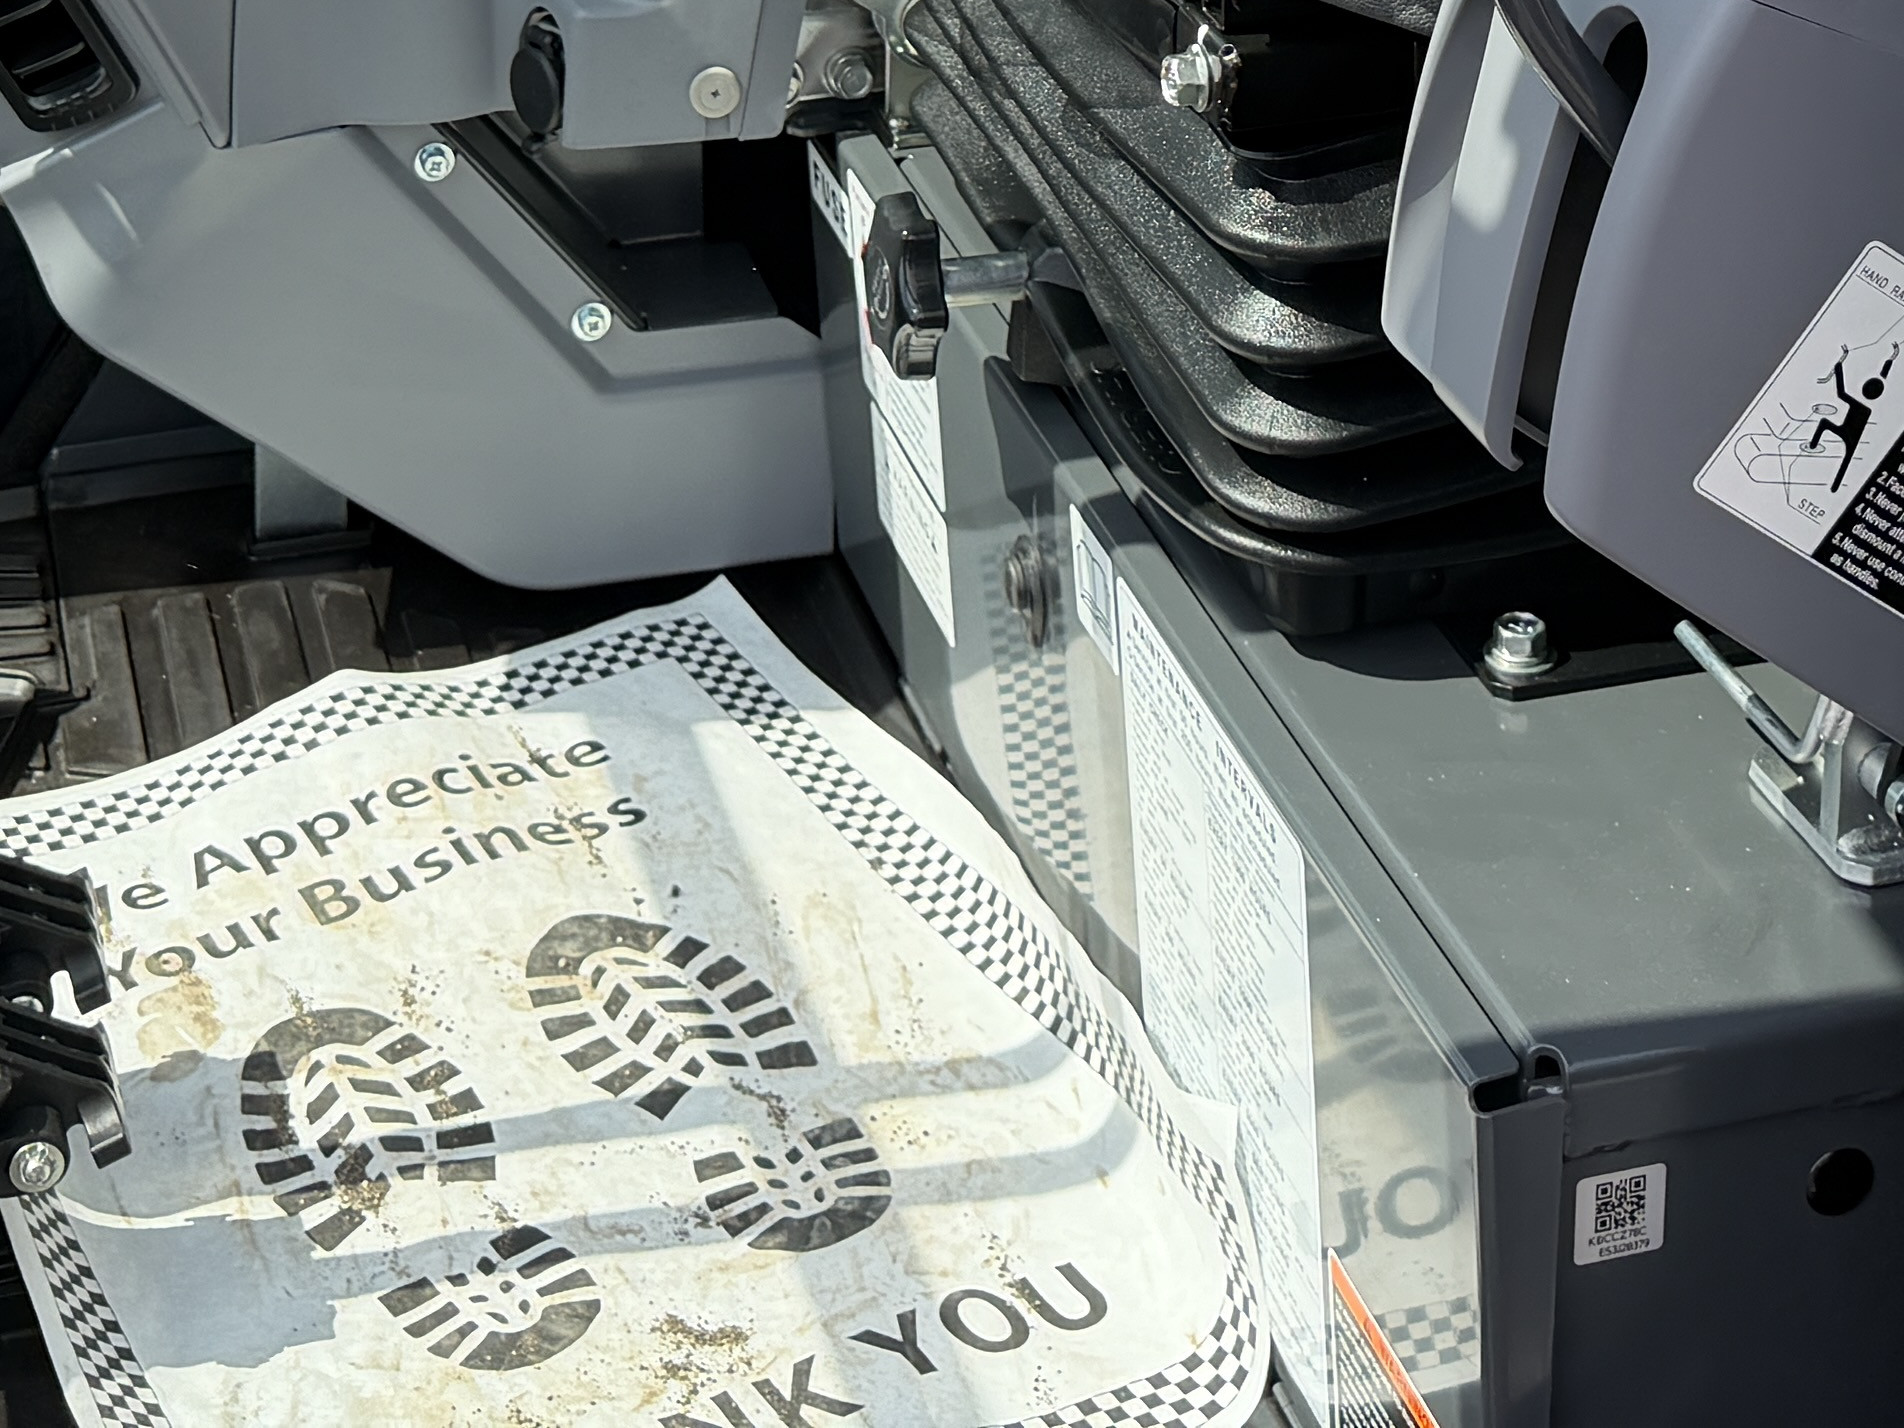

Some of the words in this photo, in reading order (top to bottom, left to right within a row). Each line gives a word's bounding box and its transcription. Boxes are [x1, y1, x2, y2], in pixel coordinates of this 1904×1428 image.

[813, 159, 848, 238] FUSE
[1859, 264, 1889, 289] HAND
[1797, 498, 1826, 519] STEP
[1829, 552, 1845, 567] as
[1851, 522, 1898, 557] dismount
[1892, 549, 1903, 561] a
[1867, 554, 1886, 573] use
[1131, 612, 1203, 733] MAINTENANCE
[1215, 739, 1277, 844] INTERVALS
[191, 738, 612, 889] Appreciate
[105, 905, 283, 993] Your
[296, 796, 648, 927] Business
[847, 1261, 1108, 1376] YOU
